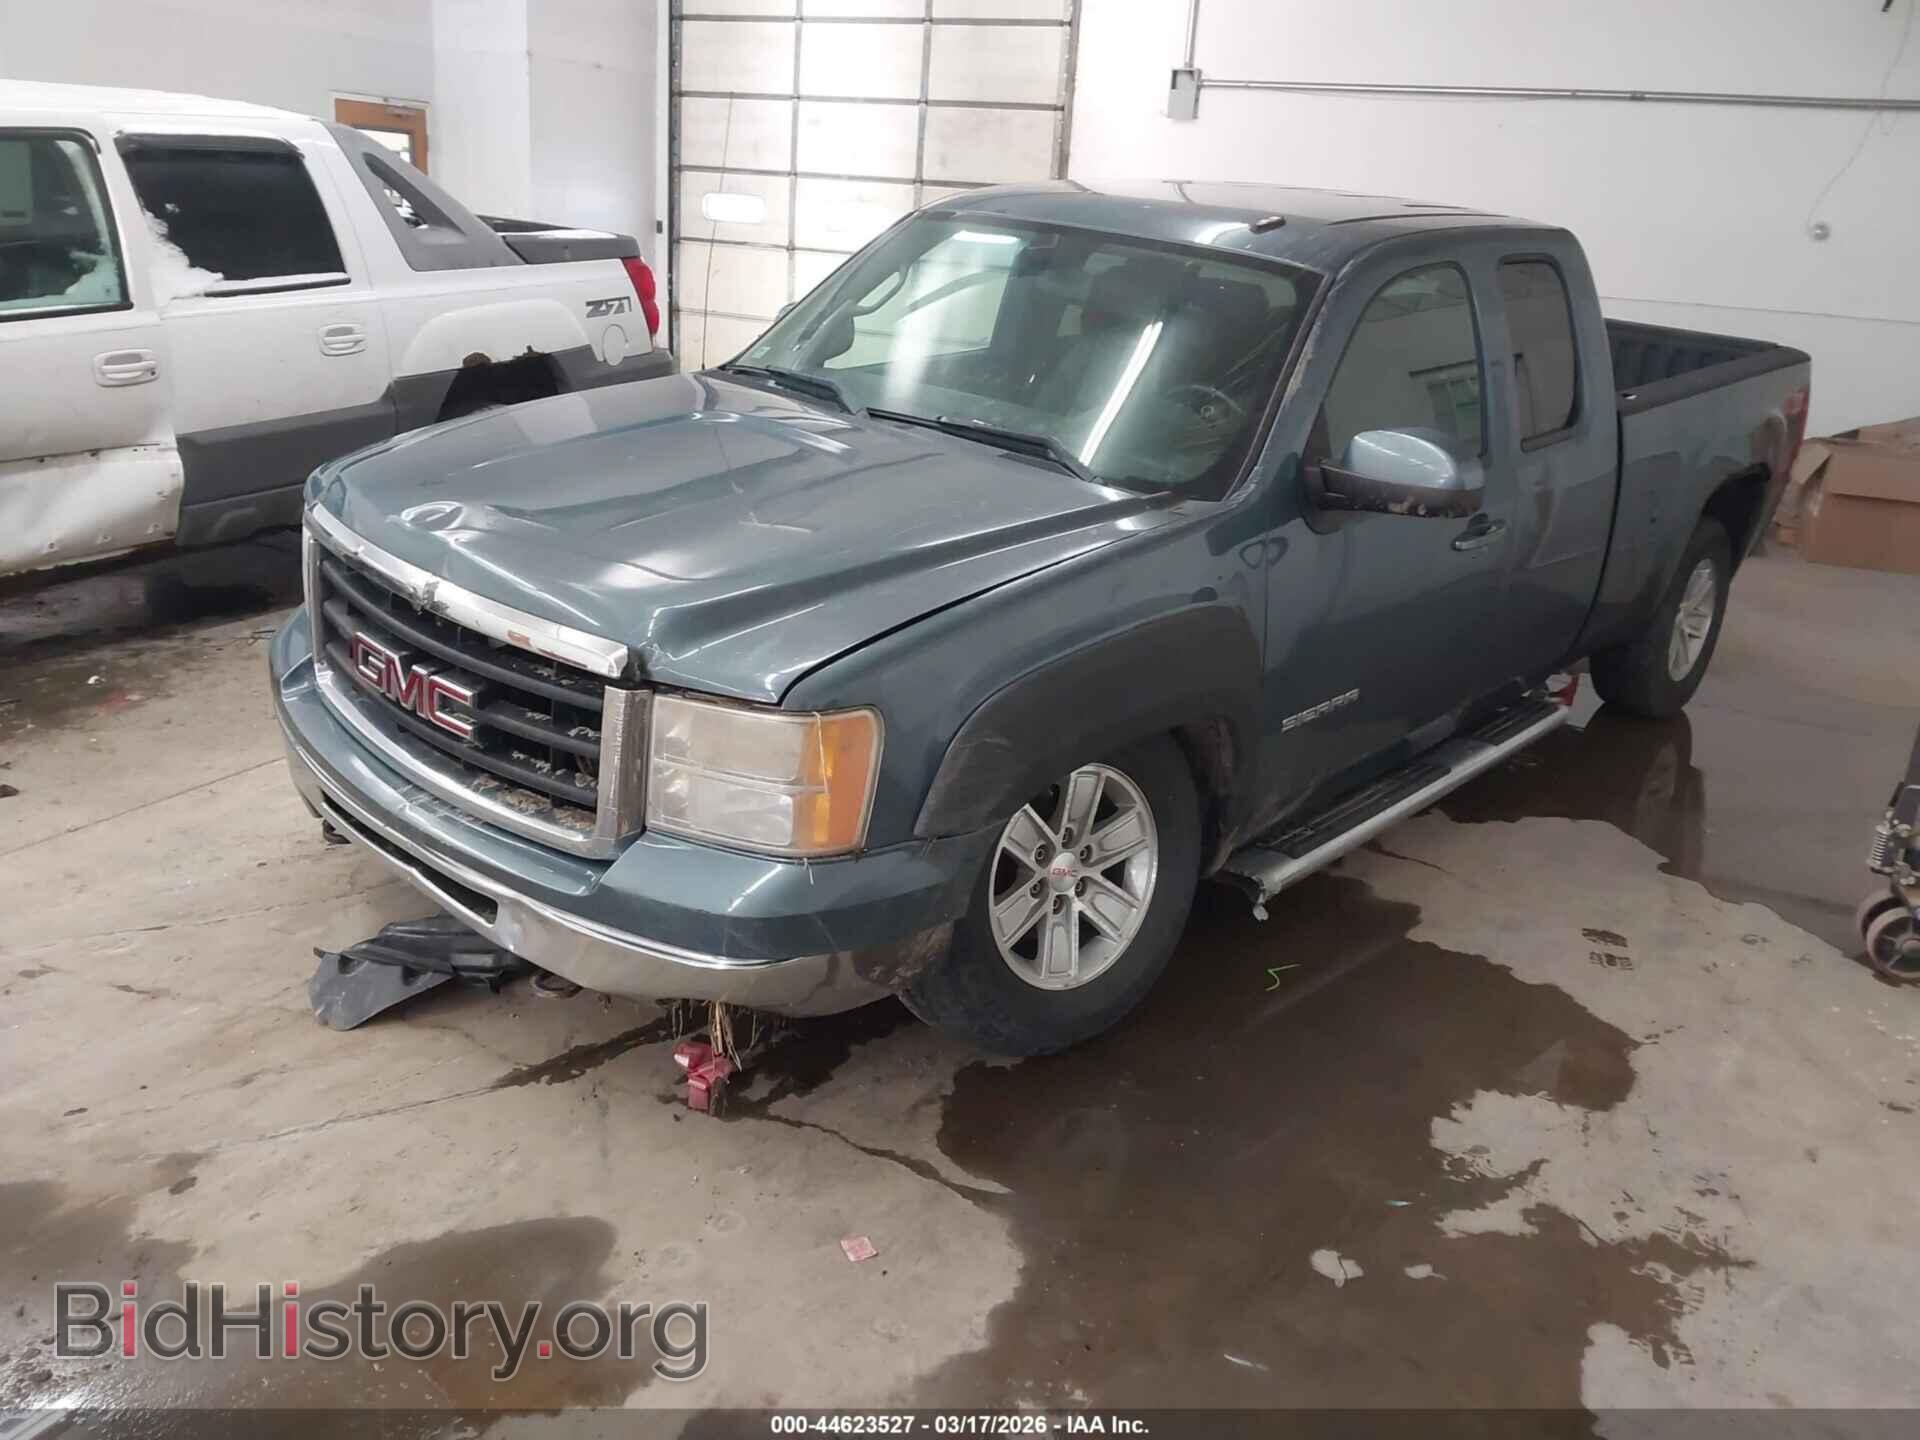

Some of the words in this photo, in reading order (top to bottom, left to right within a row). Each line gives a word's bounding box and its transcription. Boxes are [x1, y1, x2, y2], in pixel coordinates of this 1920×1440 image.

[585, 296, 632, 318] Z71
[351, 631, 475, 740] GMC
[1281, 688, 1360, 733] SIERRA
